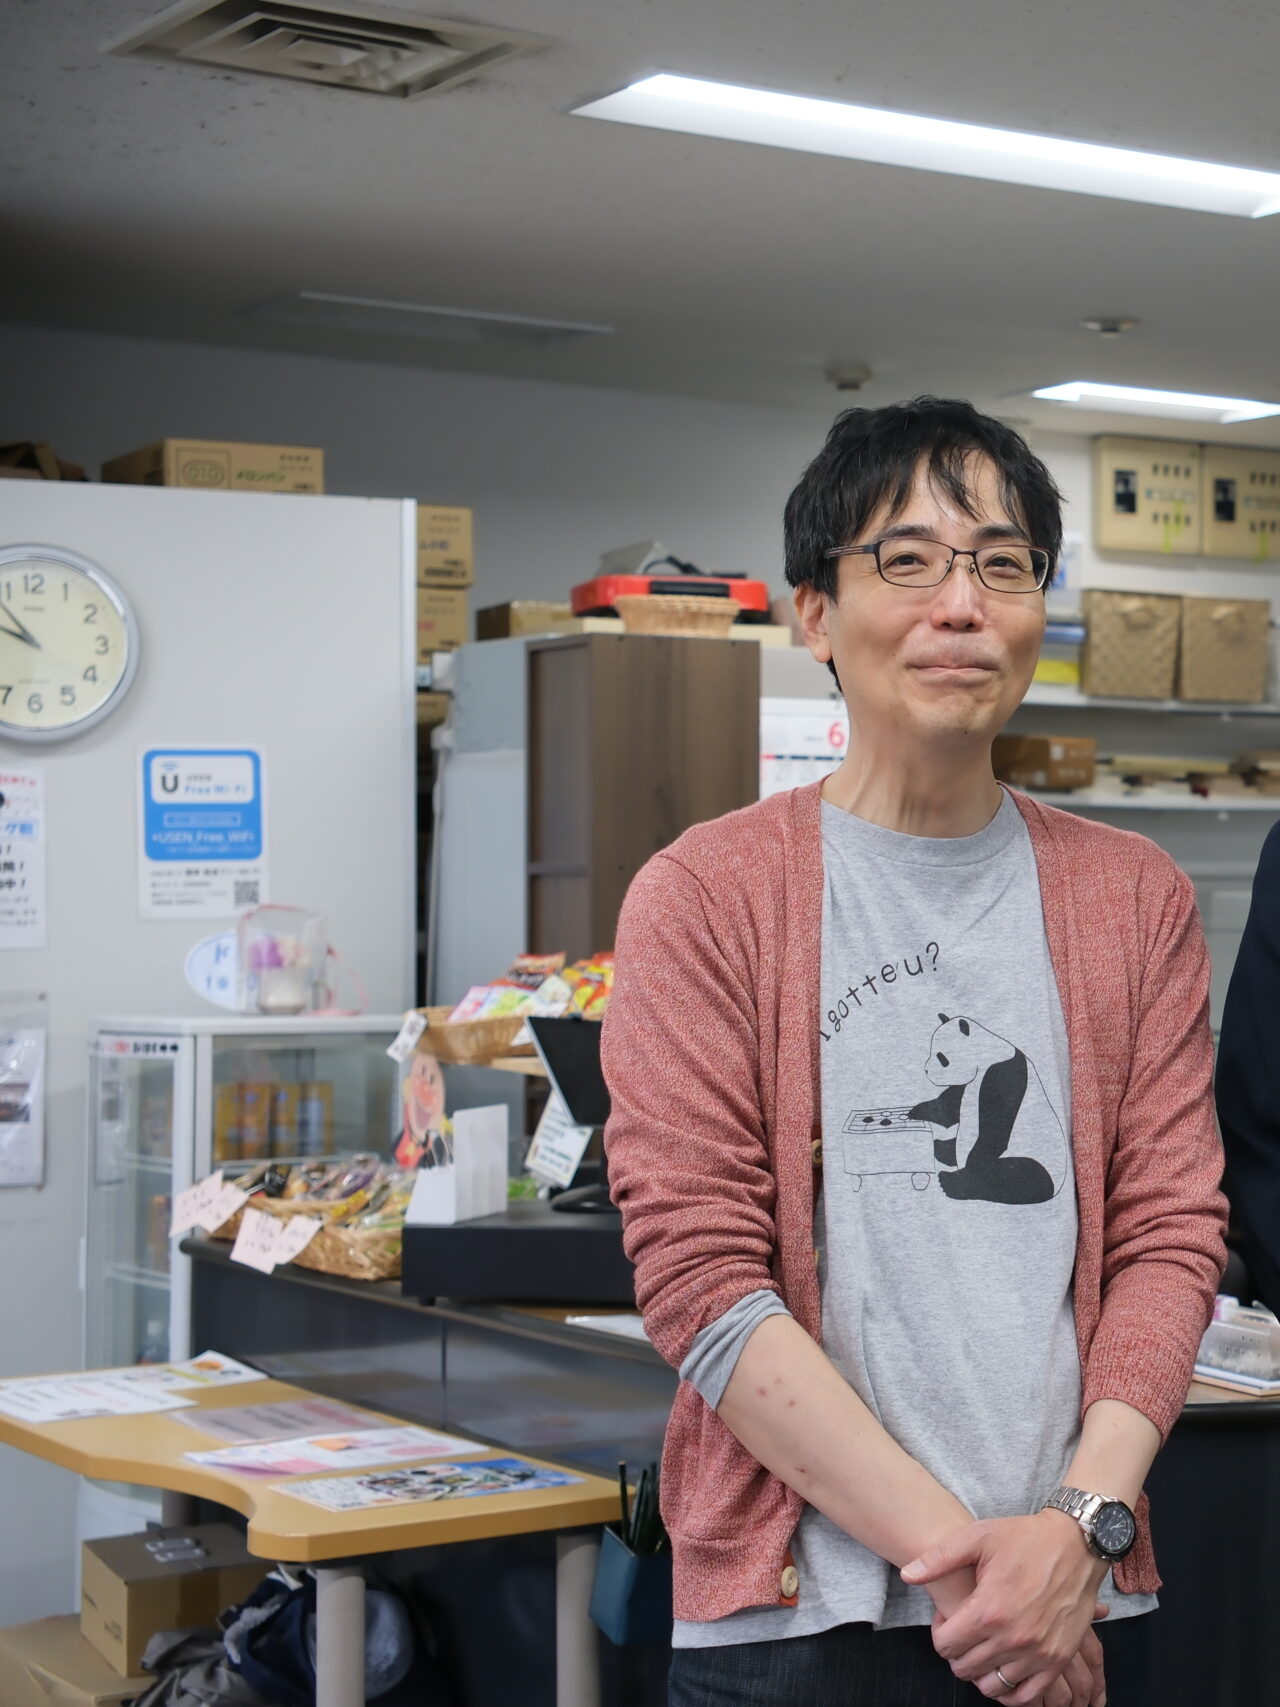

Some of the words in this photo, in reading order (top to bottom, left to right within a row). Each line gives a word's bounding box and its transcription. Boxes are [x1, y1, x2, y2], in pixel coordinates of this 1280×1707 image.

[23, 573, 45, 595] 12
[62, 581, 69, 602] 1
[83, 603, 98, 624] 2
[95, 634, 109, 656] 3
[82, 665, 98, 684] 4
[0, 685, 13, 706] 7
[27, 692, 43, 714] 6
[60, 685, 76, 706] 5
[828, 721, 845, 748] 6
[161, 773, 179, 794] U
